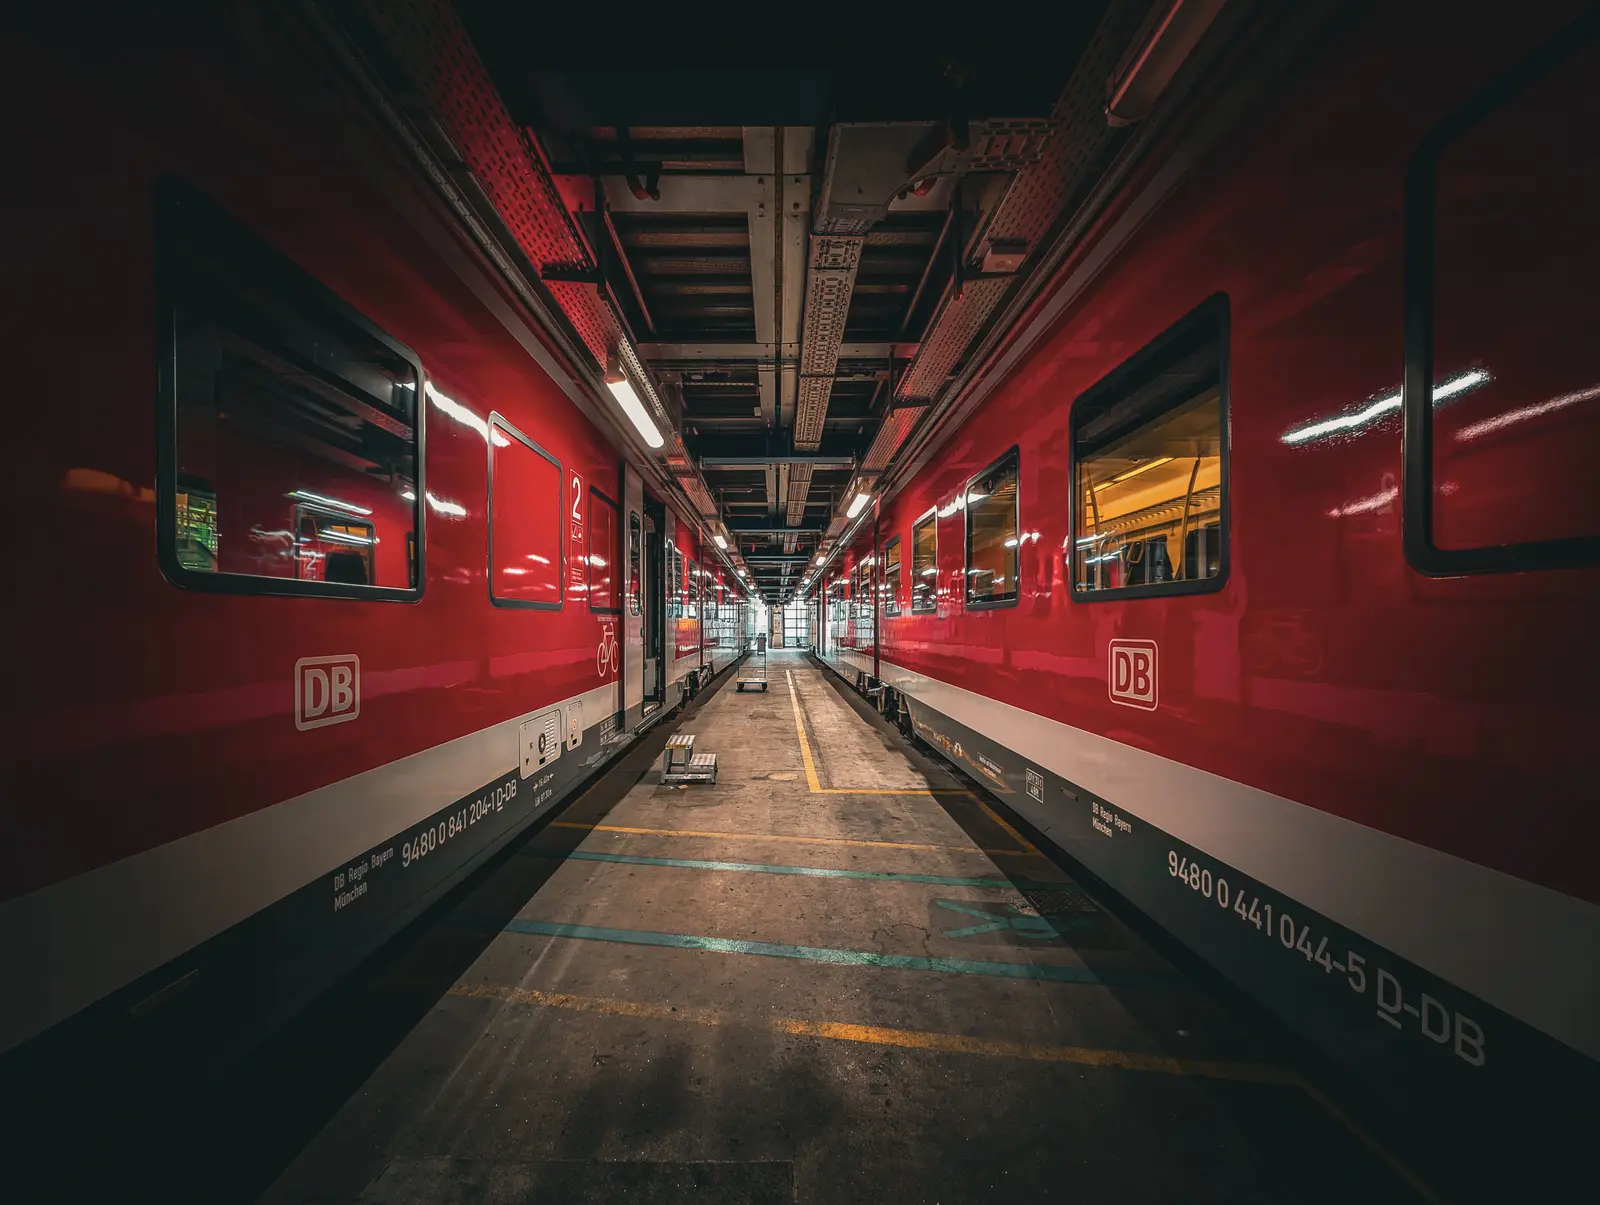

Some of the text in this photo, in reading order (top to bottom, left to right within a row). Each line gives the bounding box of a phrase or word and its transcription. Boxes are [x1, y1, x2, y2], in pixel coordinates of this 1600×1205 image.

[572, 476, 582, 521] 2
[304, 665, 354, 719] DB
[1115, 650, 1152, 697] DB
[402, 779, 517, 868] 9480 0 841 204-1 D-DB
[1092, 801, 1132, 834] DB Regio Bayern
[1092, 816, 1113, 838] München
[334, 847, 394, 892] DB Regio Bayern
[334, 881, 368, 912] München
[1168, 850, 1486, 1067] 9480 0 441 044-5 D-DB
